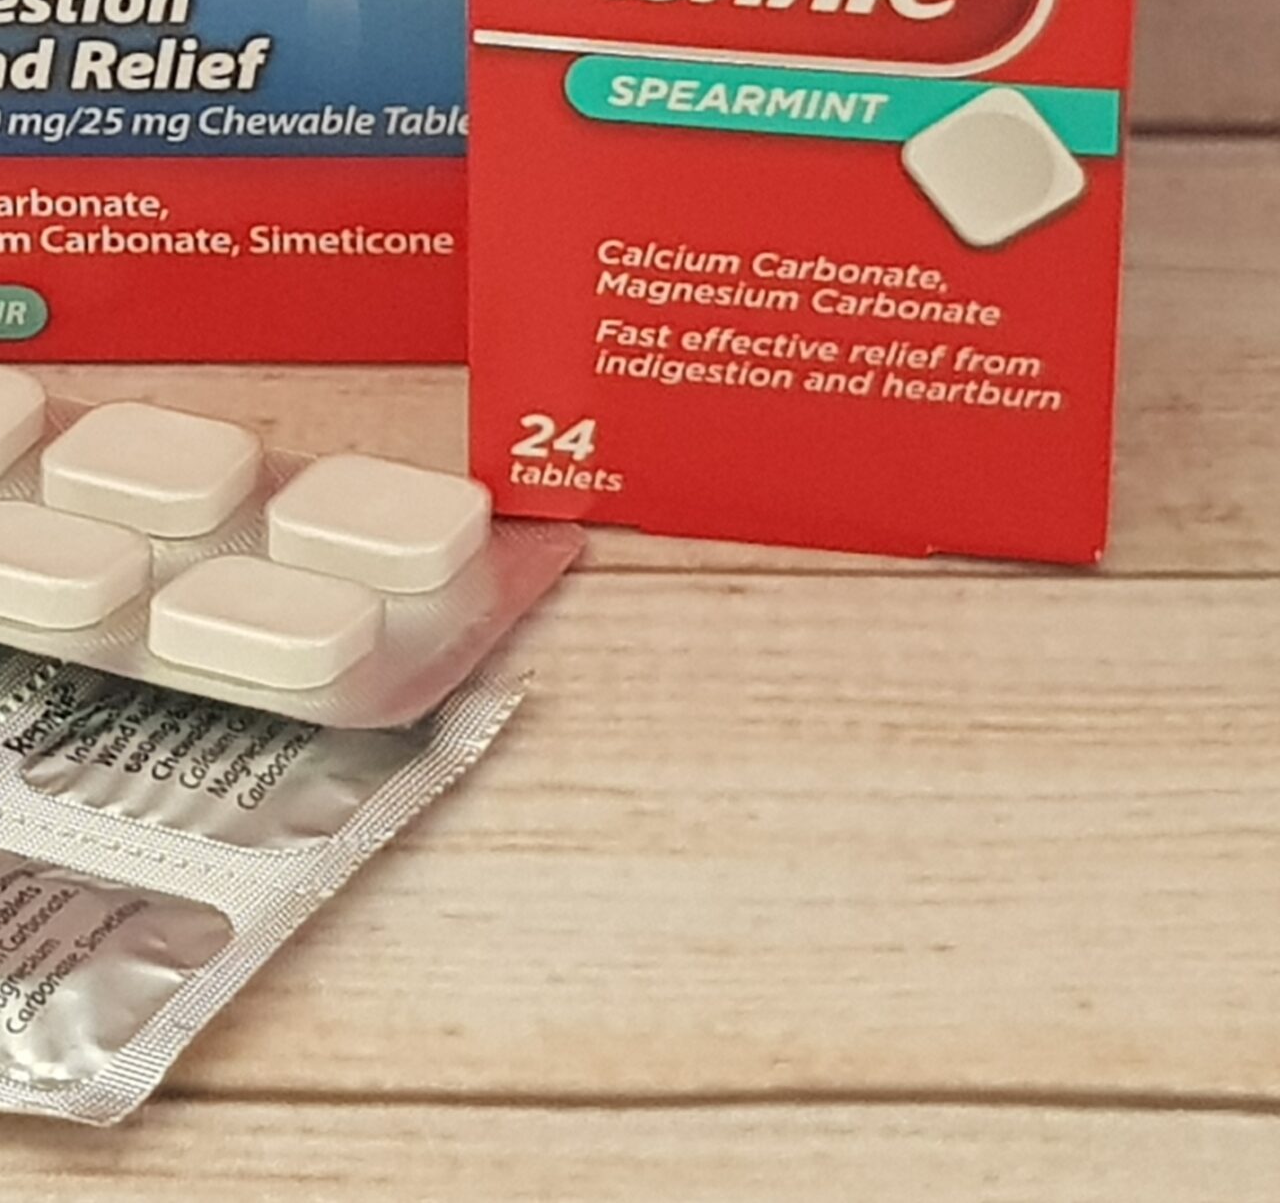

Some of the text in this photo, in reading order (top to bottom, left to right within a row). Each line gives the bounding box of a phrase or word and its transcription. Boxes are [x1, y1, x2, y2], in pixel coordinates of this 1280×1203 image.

[71, 35, 269, 91] Relief
[9, 105, 123, 142] mg/25
[131, 114, 189, 143] mg
[198, 105, 376, 135] Chewable
[608, 76, 889, 125] SPEARMINT
[40, 226, 240, 257] Carbonate,
[249, 226, 454, 254] Simeticone
[597, 239, 948, 293] Calcium Carbonate,
[596, 272, 1001, 326] Magnesium Carbonate
[596, 319, 1041, 377] Fast effective relief from
[596, 350, 1062, 412] indigestion and heartburn
[511, 414, 596, 461] 24
[510, 462, 623, 492] tablets
